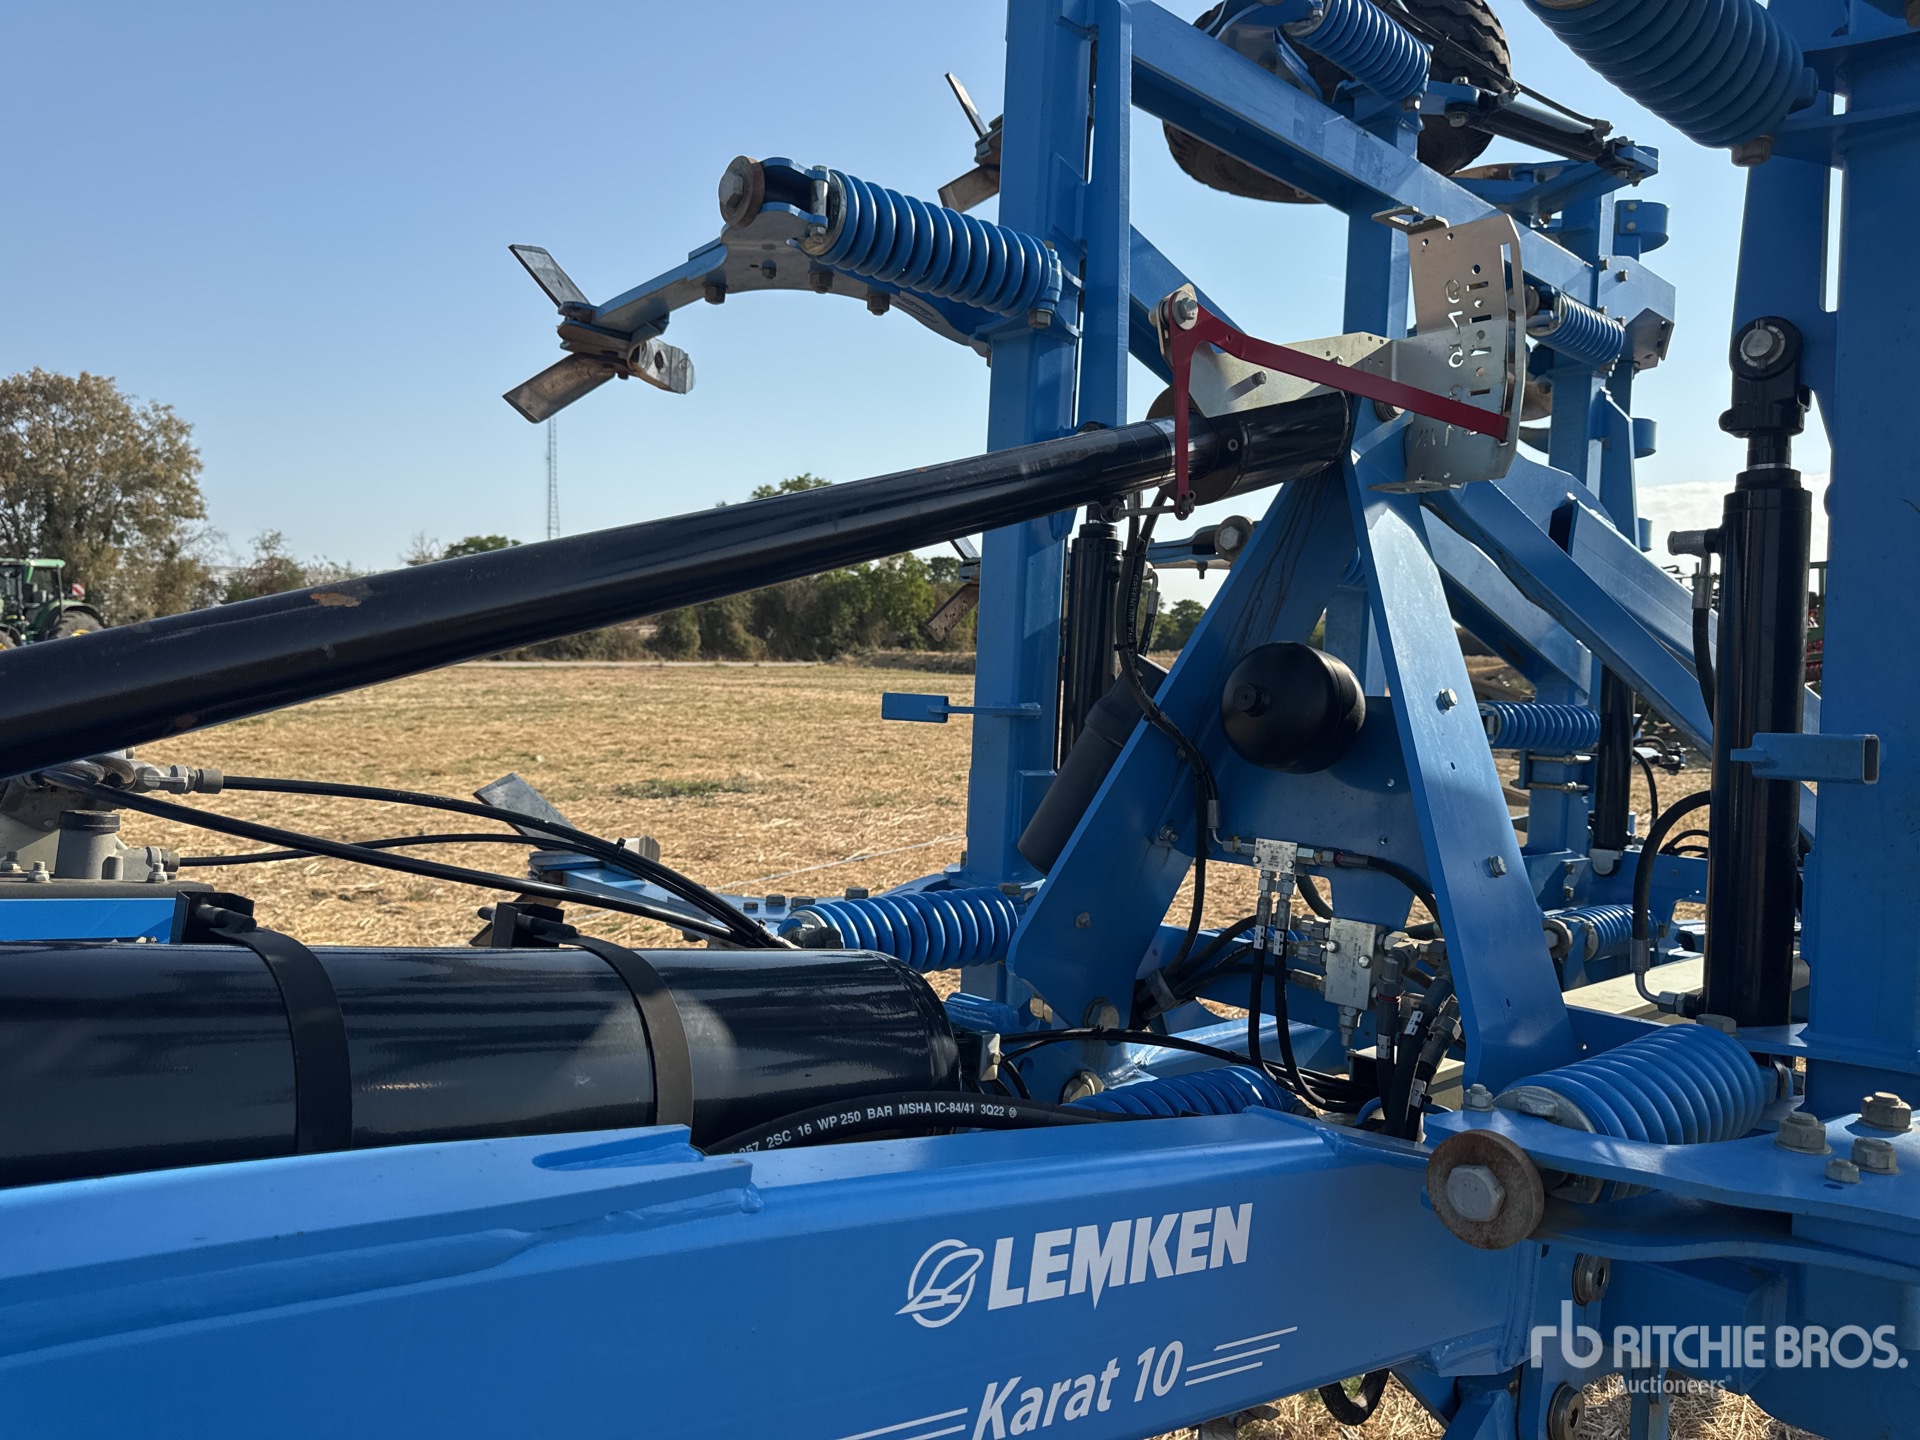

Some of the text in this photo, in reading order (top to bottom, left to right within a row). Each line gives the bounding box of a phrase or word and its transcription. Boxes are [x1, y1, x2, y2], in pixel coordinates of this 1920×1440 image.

[766, 1130, 792, 1149] 2SC
[797, 1123, 812, 1137] 16
[817, 1115, 838, 1131] WP
[841, 1110, 861, 1126] 250
[867, 1105, 893, 1120] BAR
[899, 1103, 932, 1116] MSHA
[980, 1104, 1005, 1117] 3Q22
[987, 1202, 1253, 1311] LEMKEN
[971, 1340, 1185, 1440] Karat 10
